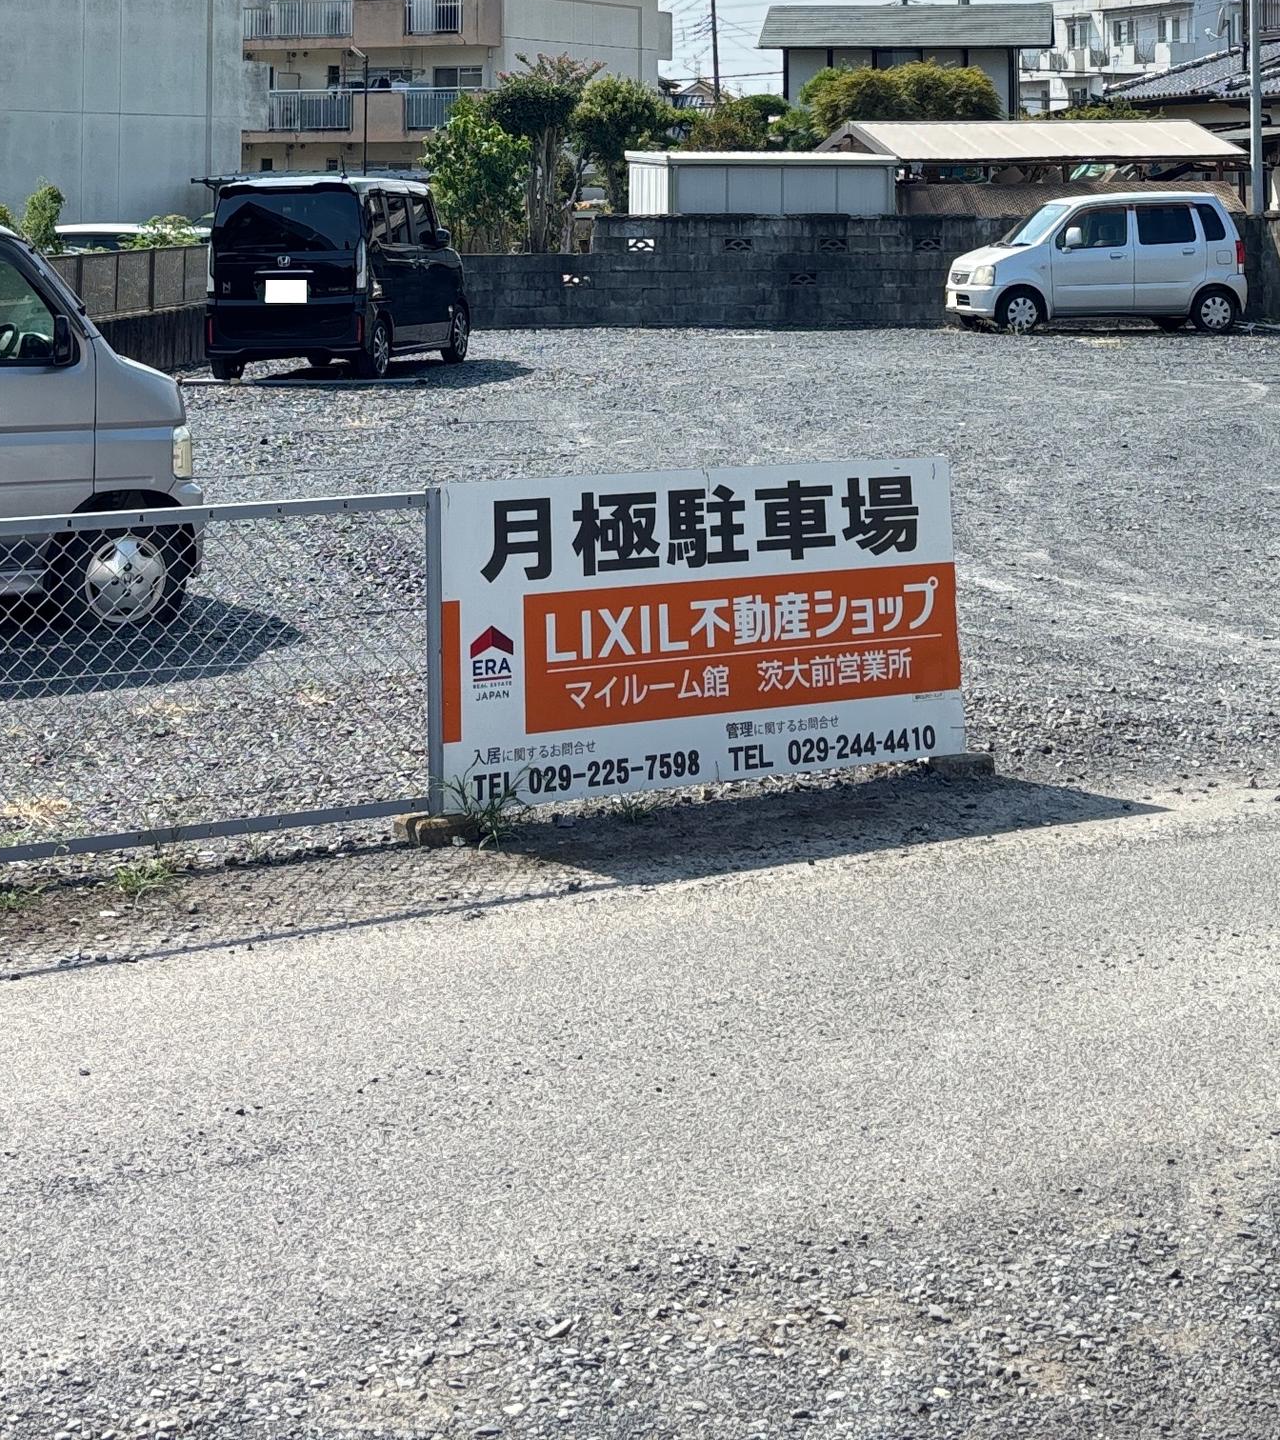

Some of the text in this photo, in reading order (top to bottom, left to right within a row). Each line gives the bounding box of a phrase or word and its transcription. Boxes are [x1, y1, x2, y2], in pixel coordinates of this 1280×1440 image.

[480, 475, 919, 584] 月極駐車場
[545, 576, 939, 664] LIXIL不動産ショップ
[472, 657, 512, 676] ERA
[565, 647, 913, 710] マイルーム館 茨大前営業所
[476, 690, 510, 702] JAPAN
[726, 715, 839, 739] 管理に関するお問合せ
[728, 725, 936, 772] TEL 029-244-4410
[472, 739, 596, 766] 入居に関するお問合せ
[473, 749, 701, 801] TEL 029-225-7598
